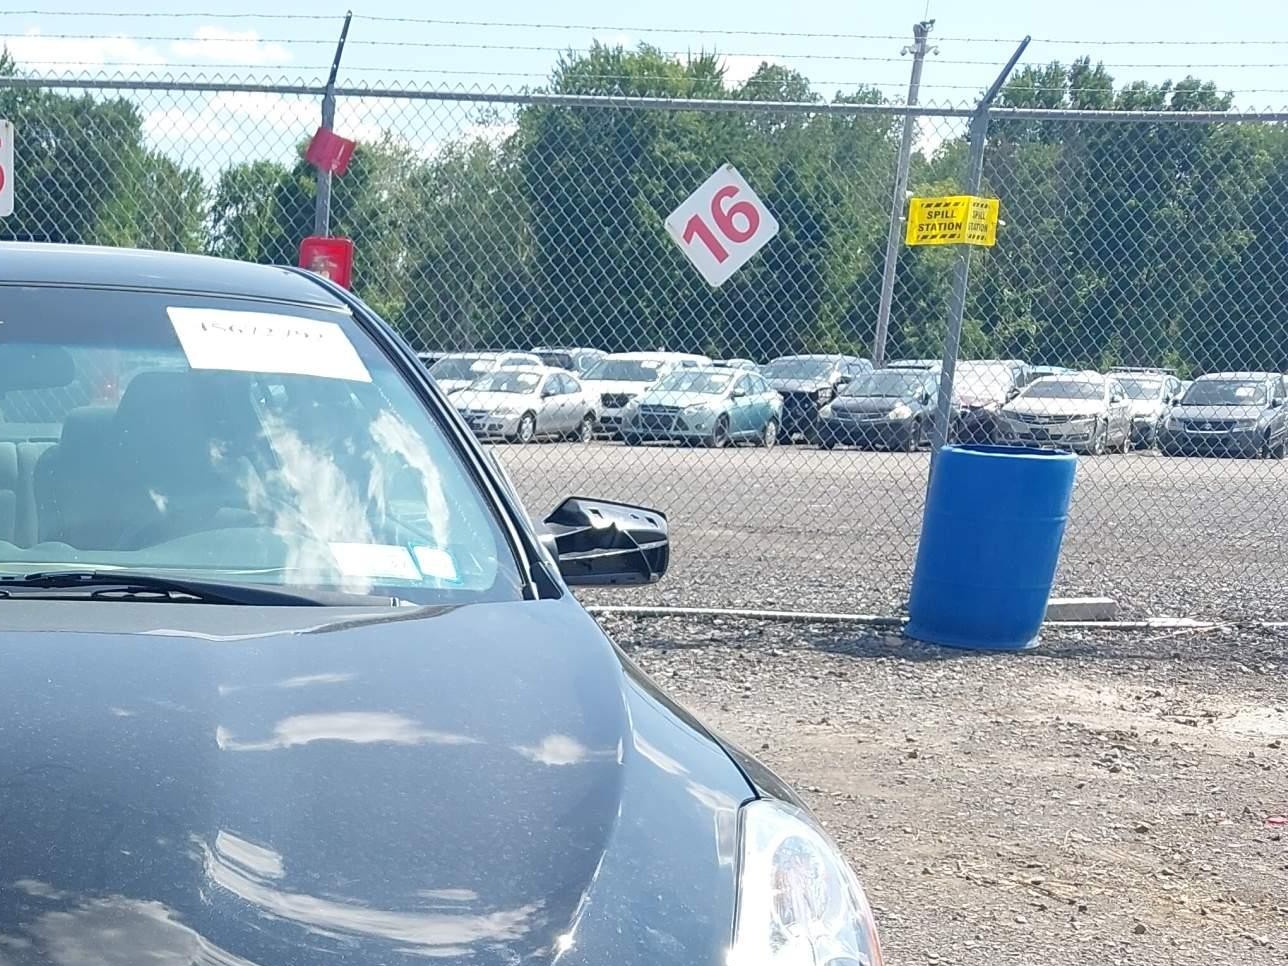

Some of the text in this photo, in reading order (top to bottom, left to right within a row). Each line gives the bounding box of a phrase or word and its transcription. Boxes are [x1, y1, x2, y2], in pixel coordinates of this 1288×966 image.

[926, 211, 956, 219] SPILL
[682, 185, 760, 264] 16
[918, 223, 962, 232] STATION
